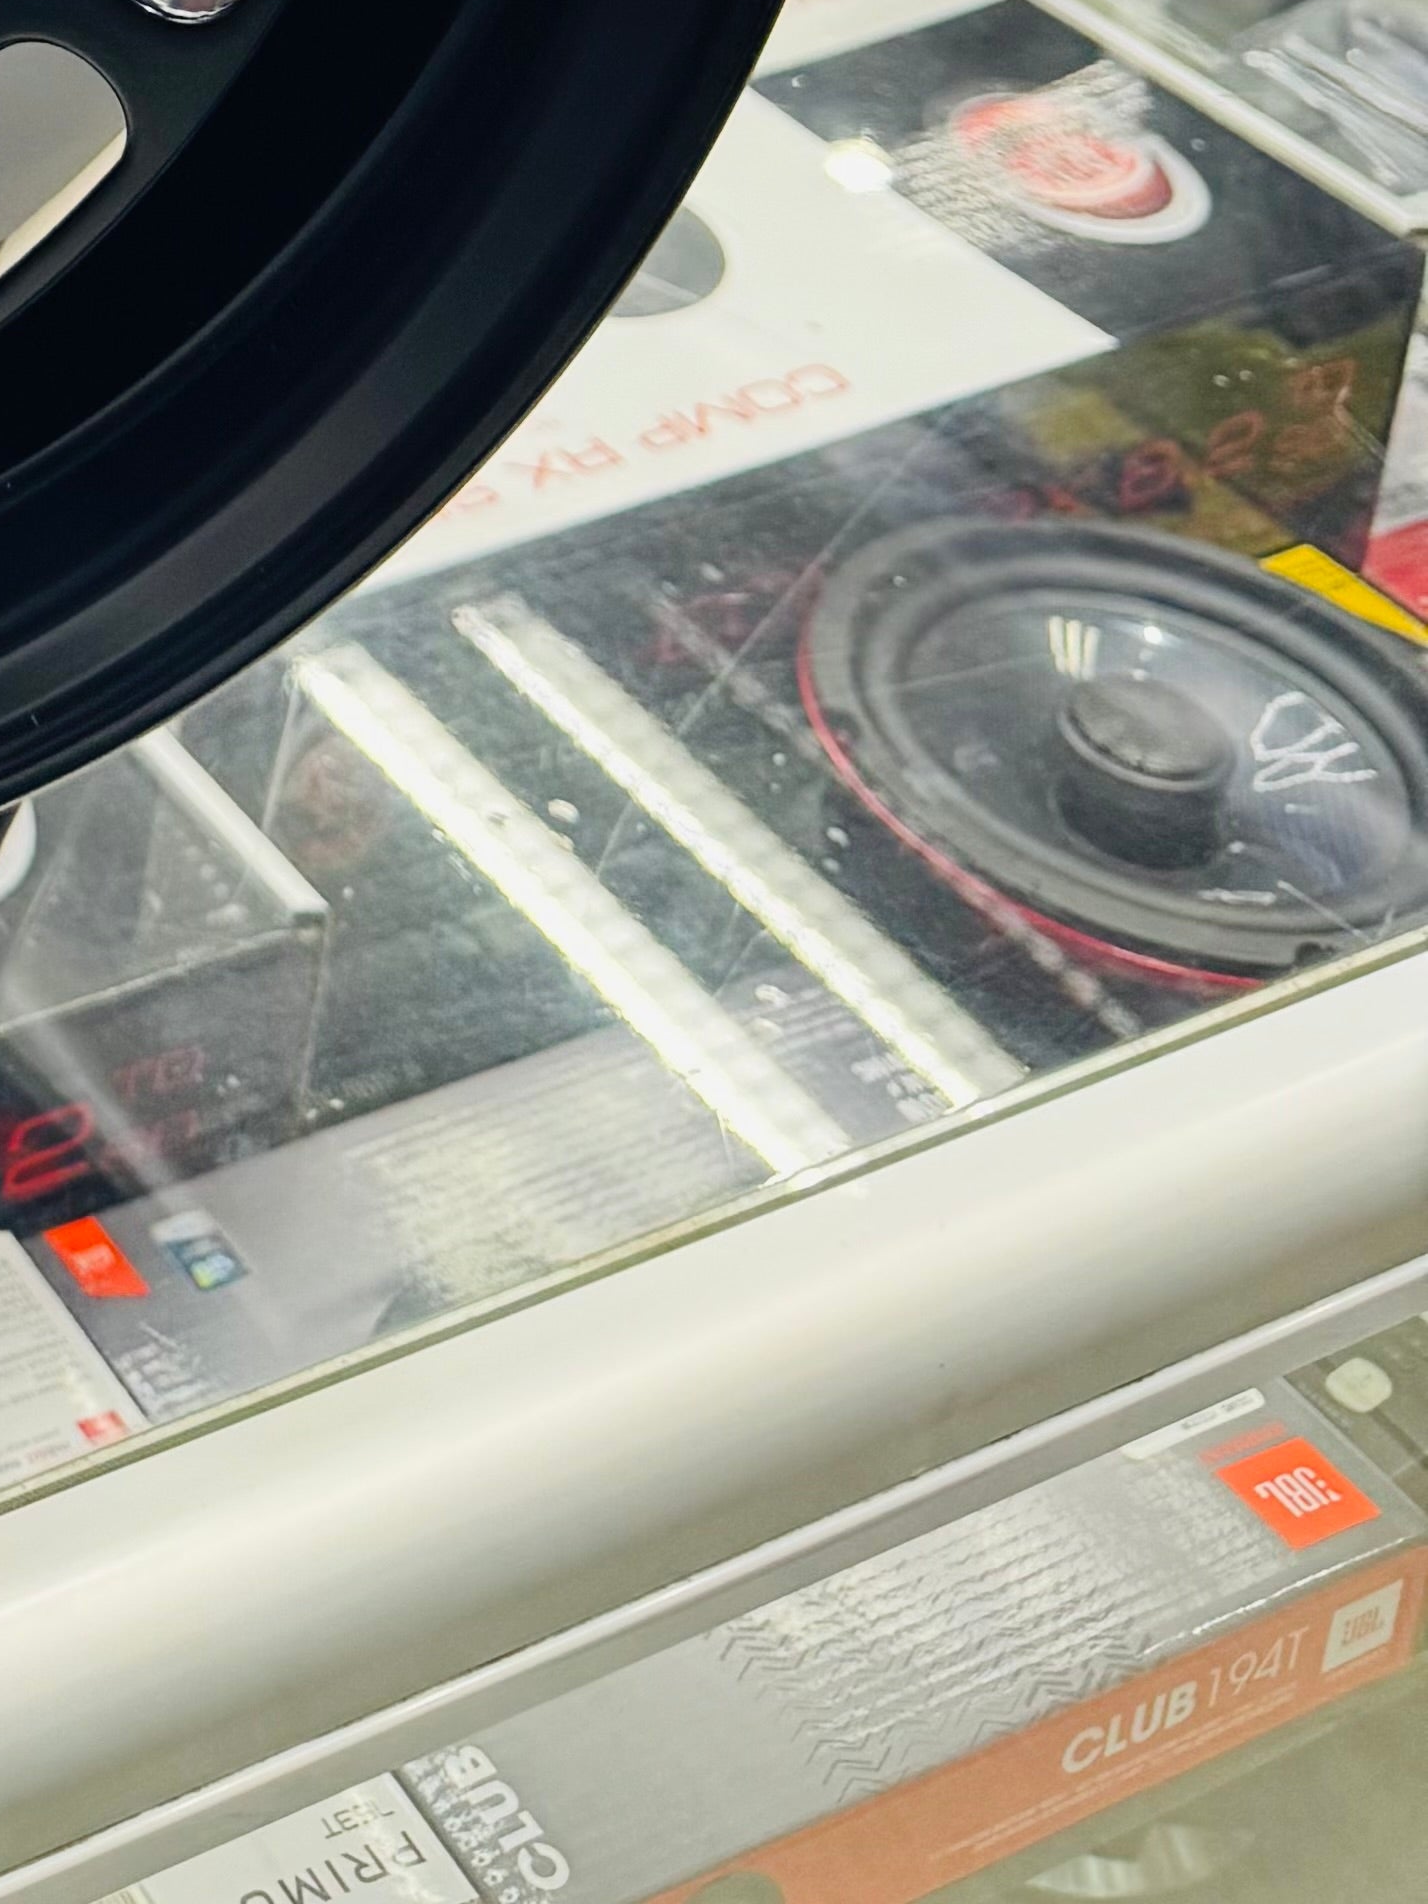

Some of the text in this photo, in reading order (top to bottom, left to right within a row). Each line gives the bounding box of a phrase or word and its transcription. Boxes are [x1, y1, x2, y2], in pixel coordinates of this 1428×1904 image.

[1253, 1465, 1343, 1519] JBL
[1061, 1626, 1310, 1774] CLUB 194T
[443, 1745, 571, 1891] CLUB
